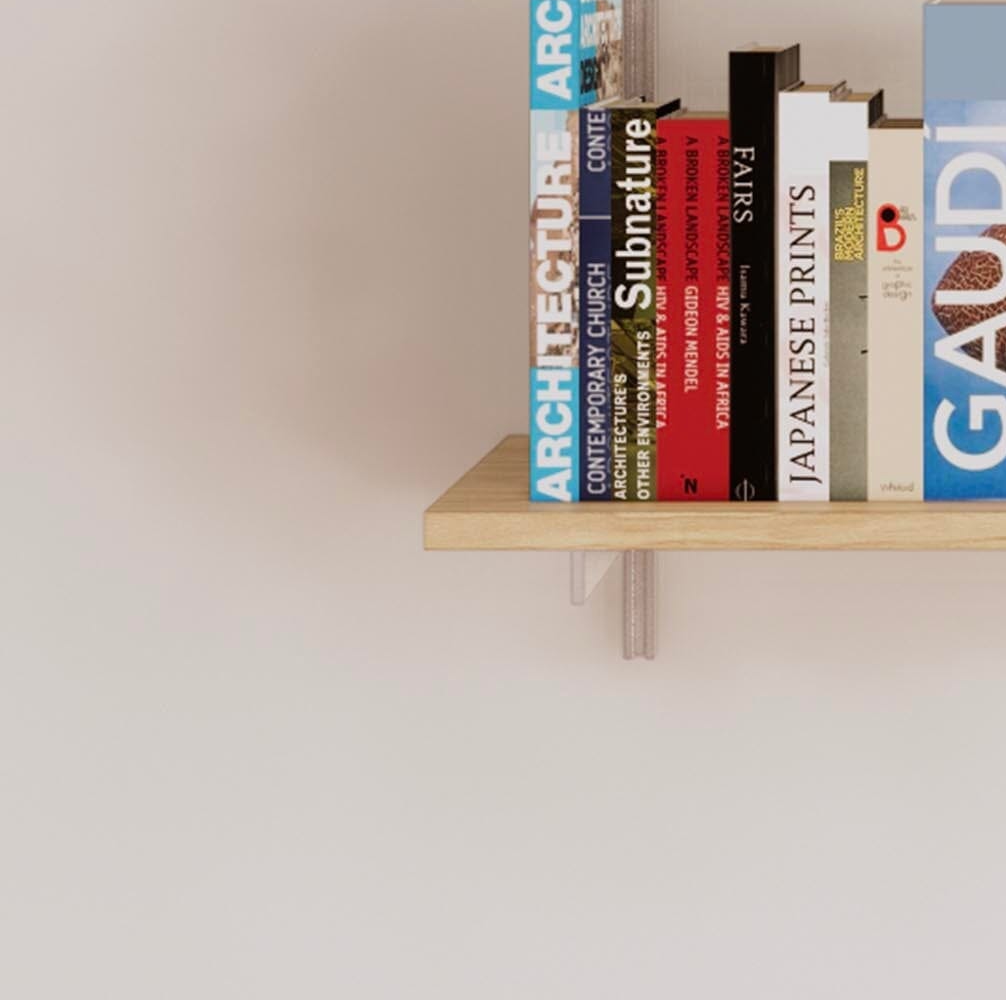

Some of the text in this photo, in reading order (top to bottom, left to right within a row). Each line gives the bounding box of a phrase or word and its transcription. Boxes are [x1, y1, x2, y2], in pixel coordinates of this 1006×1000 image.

[614, 118, 652, 310] Subnature
[684, 137, 699, 393] A BROKEN LANDSCAPE GIDEON MENDEL
[716, 137, 730, 430] A BROKEN LANDSCAPE HIV & AIDS IN AFRICA
[733, 146, 755, 224] FAIRS
[853, 167, 864, 261] ARCHITECTURE
[536, 131, 573, 501] ARCHITECTURE
[587, 262, 606, 495] CONTEMPORARY CHURCH
[636, 330, 651, 500] OTHER ENVIRONMENTS
[789, 183, 822, 484] JAPANESE PRINTS
[613, 373, 628, 500] ARCHITECTURE'S
